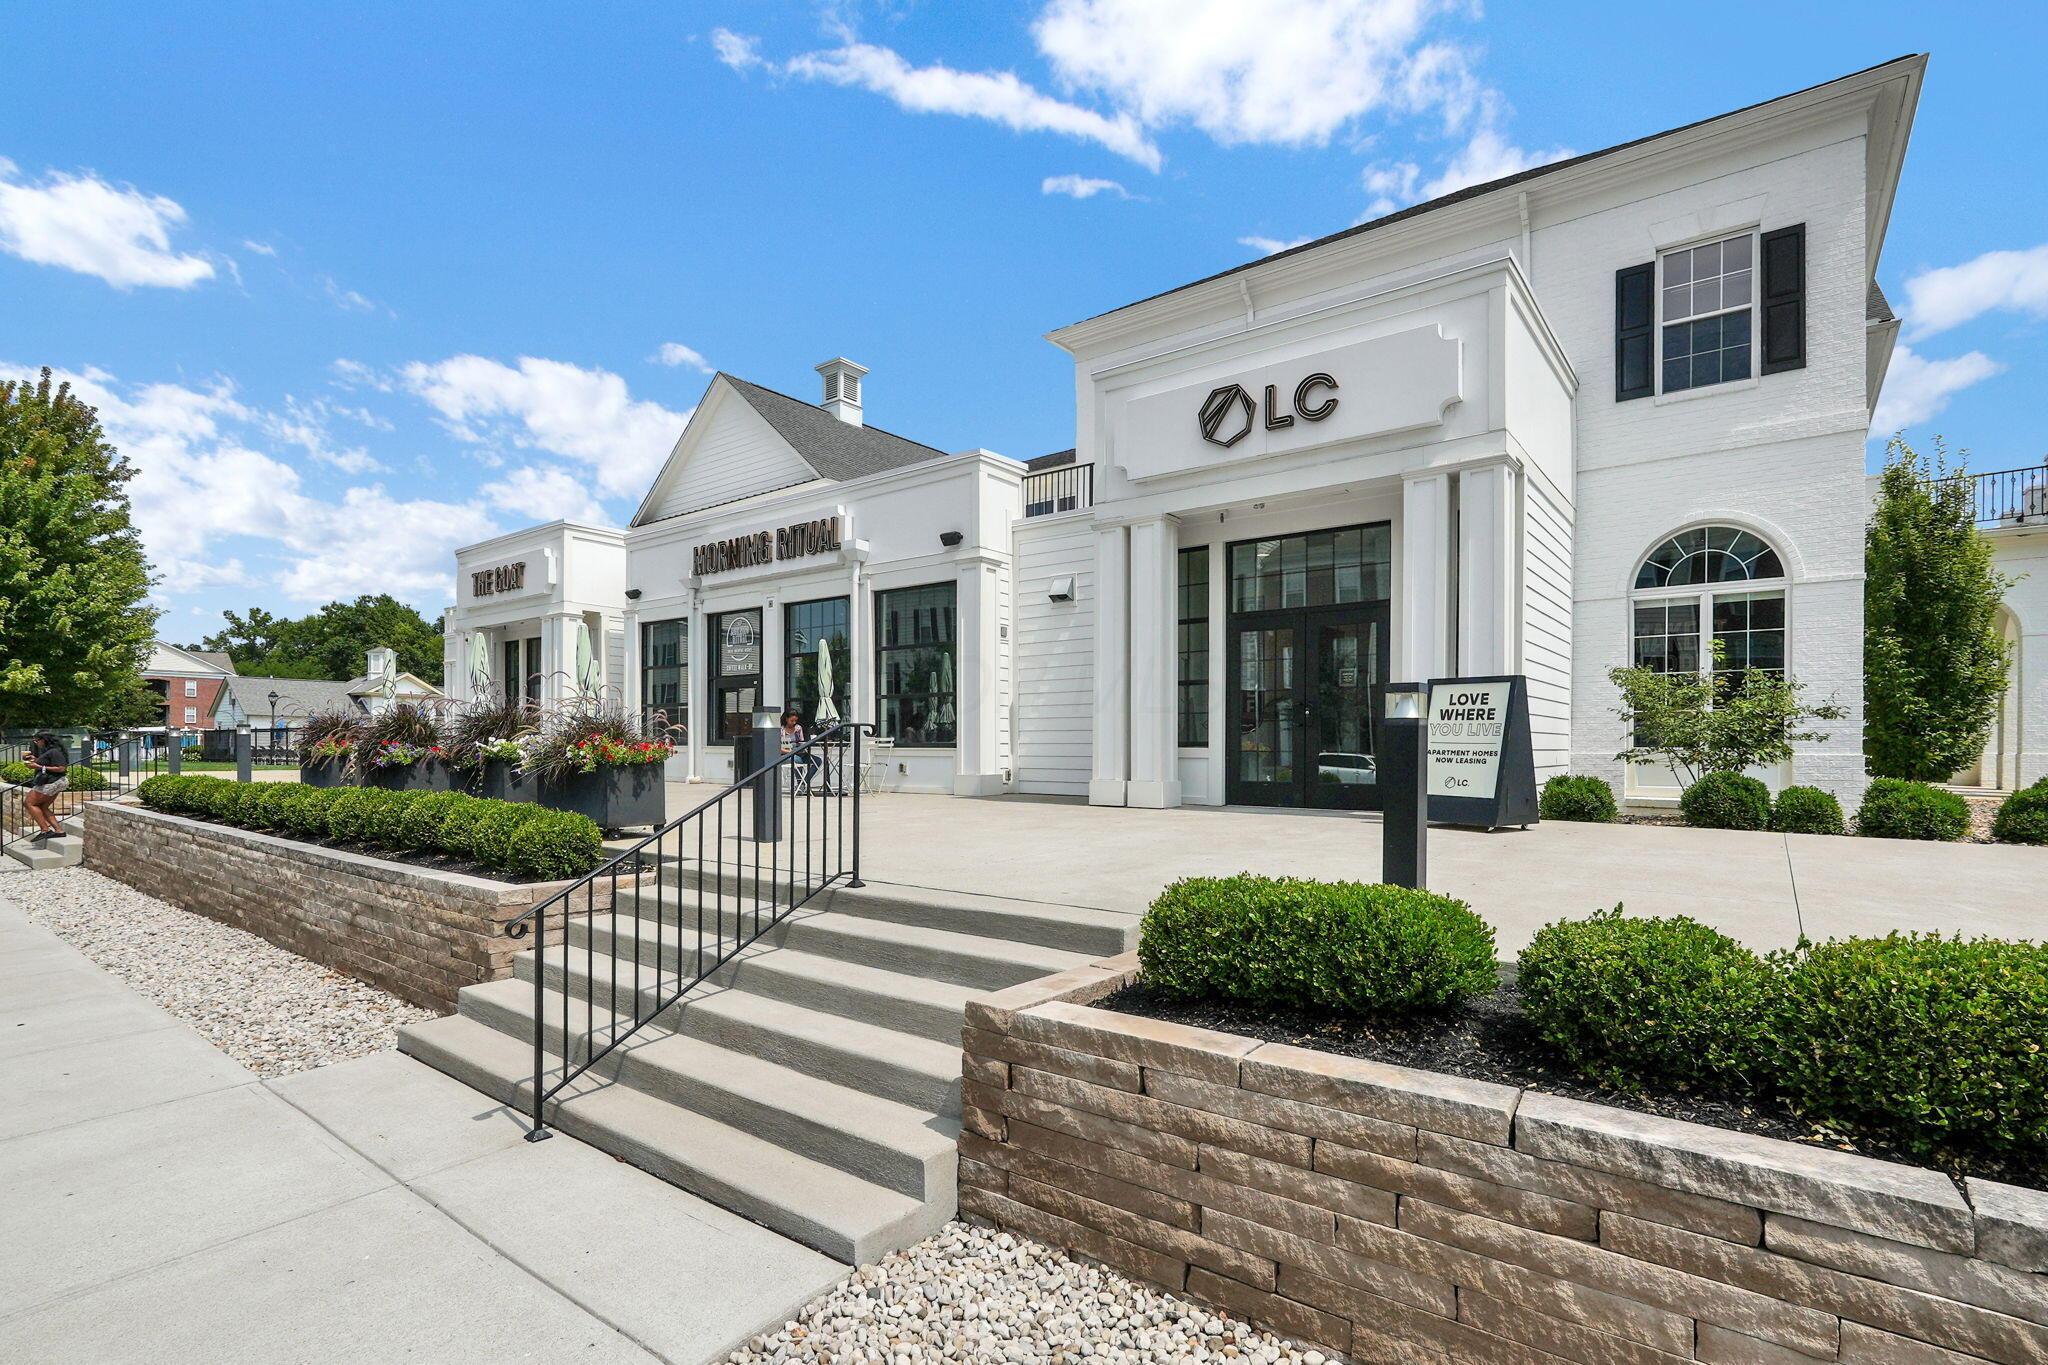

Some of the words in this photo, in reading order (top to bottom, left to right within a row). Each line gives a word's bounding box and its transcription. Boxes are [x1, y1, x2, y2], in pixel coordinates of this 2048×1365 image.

[1265, 373, 1339, 431] LC
[693, 531, 773, 576] MORNING
[776, 516, 841, 560] RITUAL
[472, 569, 495, 598] THE
[495, 561, 526, 593] GOAT
[1449, 692, 1490, 706] LOVE
[1440, 707, 1497, 721] WHERE
[1430, 722, 1463, 736] YOU
[1467, 722, 1503, 737] LIVE
[1427, 749, 1470, 757] APARTMENT
[1455, 757, 1487, 765] LEASING
